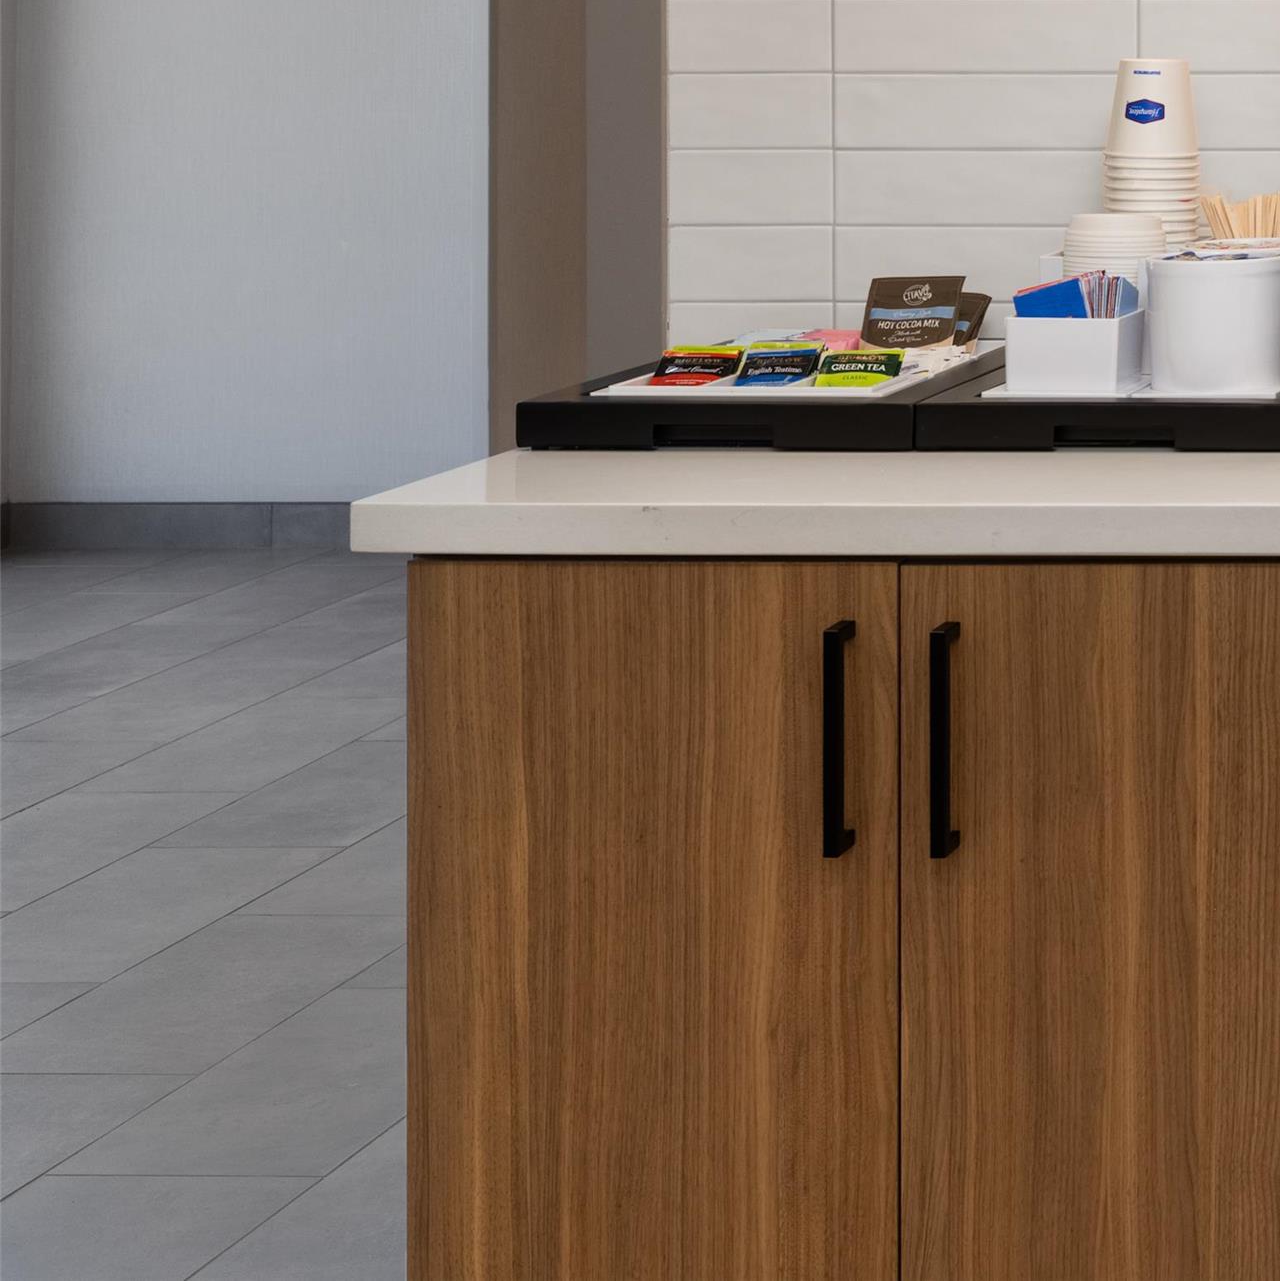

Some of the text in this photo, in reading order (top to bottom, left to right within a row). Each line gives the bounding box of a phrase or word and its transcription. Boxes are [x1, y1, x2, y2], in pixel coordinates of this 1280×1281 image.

[877, 319, 940, 329] HOT COCOA MIX
[747, 366, 772, 376] English
[831, 363, 886, 372] GREEN TEA
